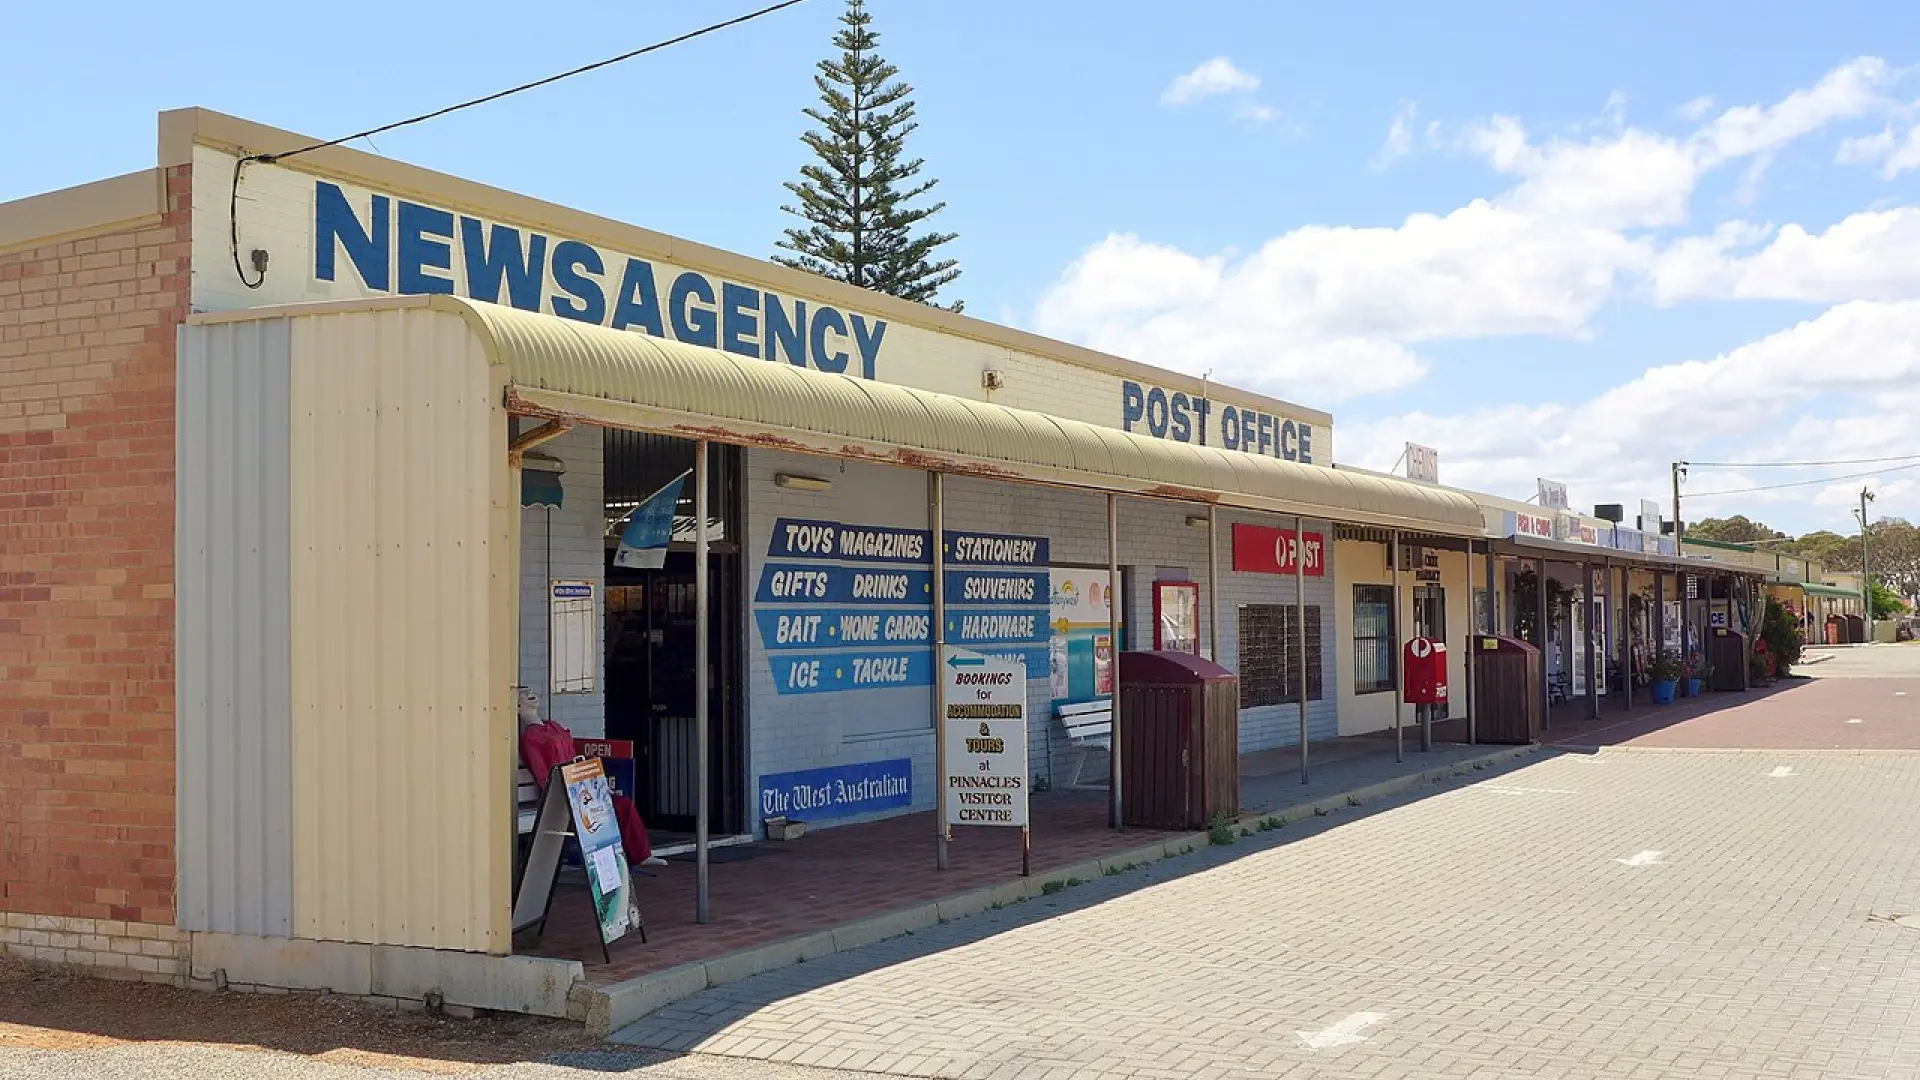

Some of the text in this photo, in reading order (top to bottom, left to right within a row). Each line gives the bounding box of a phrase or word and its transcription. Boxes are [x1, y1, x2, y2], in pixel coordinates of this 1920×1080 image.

[315, 180, 887, 380] NEWSAGENCY
[1123, 380, 1312, 464] POST OFFICE
[786, 524, 1037, 563] TOYS MAGAZINES STATIONERY
[1289, 538, 1320, 569] POST
[770, 570, 828, 598] GIFTS
[852, 573, 908, 599] DRINKS
[964, 576, 1035, 600] SOUVENIRS
[776, 615, 821, 644] BAIT
[884, 615, 930, 640] CARDS
[961, 615, 1034, 640] HARDWARE
[788, 657, 909, 688] ICE TACKLE
[955, 673, 1012, 685] BOOKINGS
[976, 689, 992, 700] for
[947, 704, 1022, 719] ACCOMMODATION
[979, 722, 990, 736] &
[584, 743, 612, 758] OPEN
[966, 738, 1004, 753] TOURS
[979, 760, 990, 771] at
[949, 776, 1021, 788] PINNACLES
[763, 773, 908, 815] The West Australian
[959, 792, 1012, 805] VISITOR
[959, 809, 1012, 821] CENTRE
